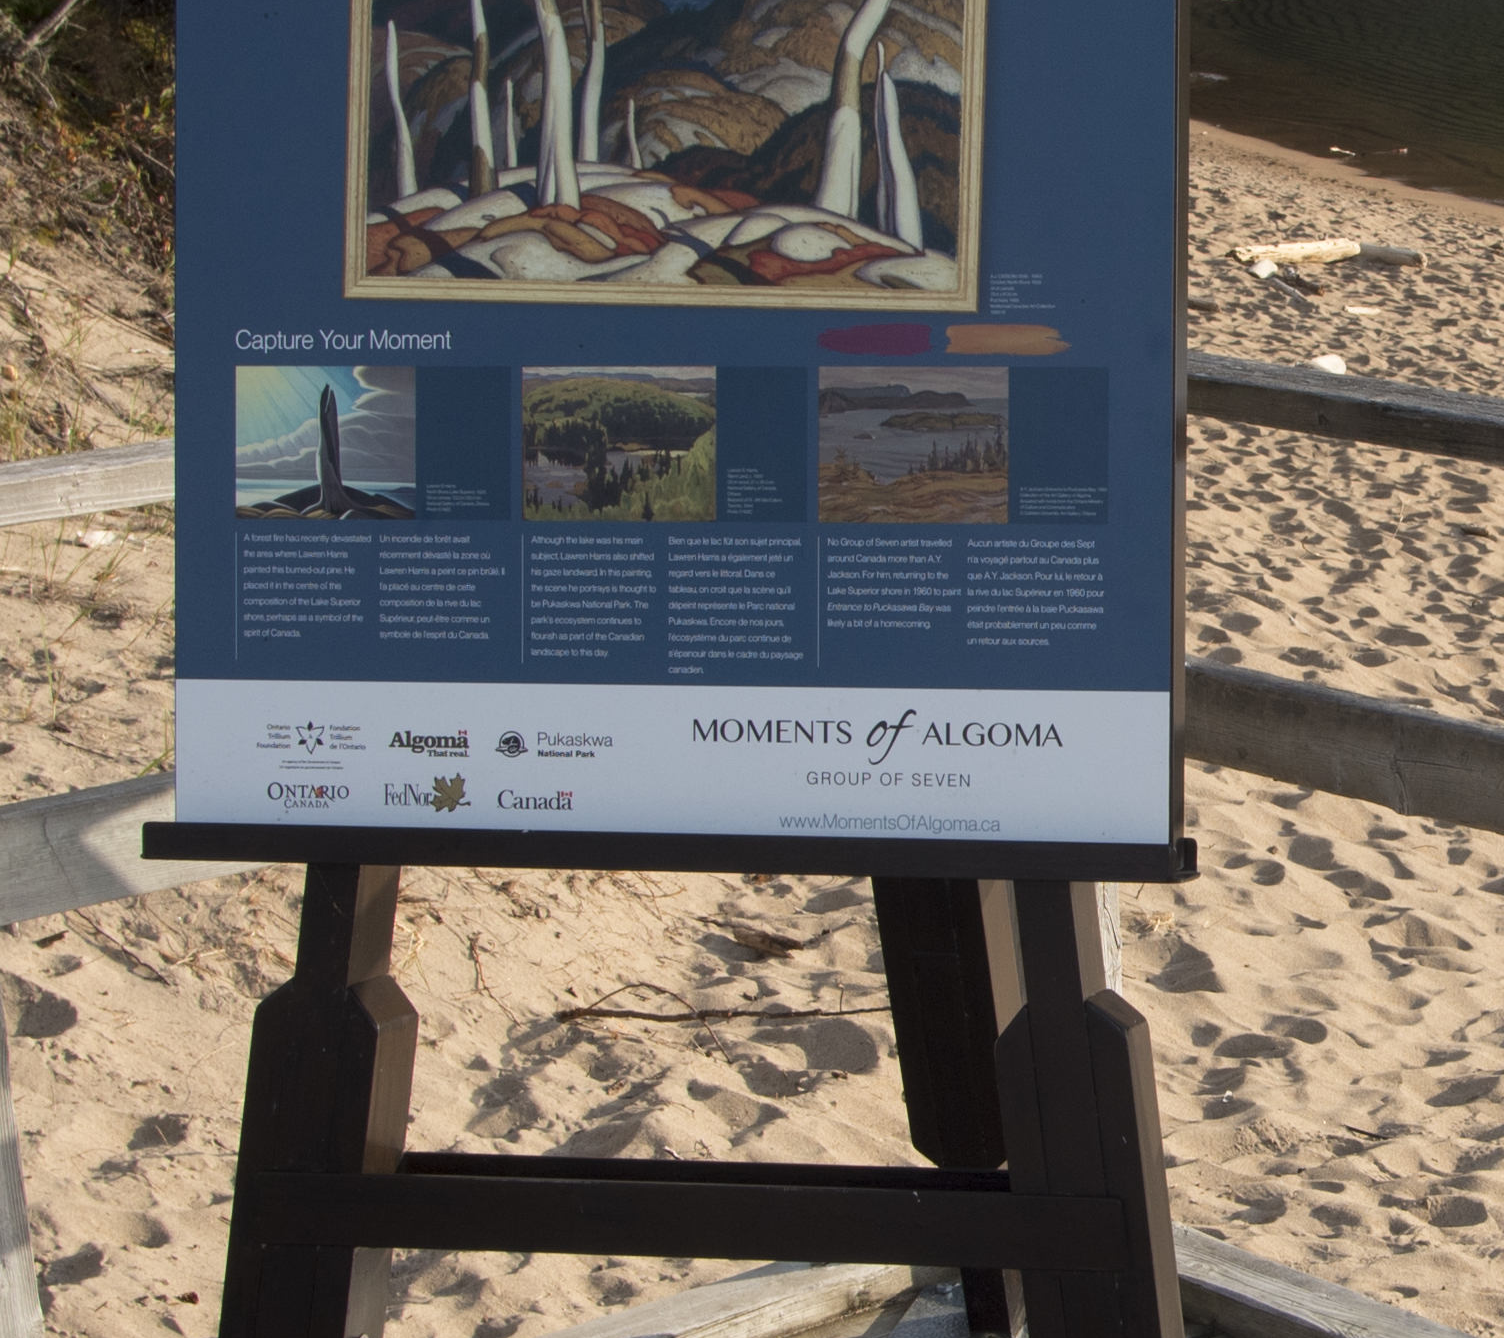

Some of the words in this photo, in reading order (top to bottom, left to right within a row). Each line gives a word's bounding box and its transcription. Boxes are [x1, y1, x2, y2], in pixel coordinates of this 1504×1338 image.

[236, 329, 313, 354] Capture
[319, 329, 364, 349] Your
[370, 330, 451, 349] Moment
[244, 533, 249, 542] A
[251, 533, 271, 542] forest
[272, 533, 284, 542] fire
[285, 533, 299, 542] had
[300, 534, 329, 543] recently
[330, 533, 371, 542] devastated
[379, 534, 390, 542] Un
[391, 534, 422, 542] incendie
[423, 534, 433, 543] de
[434, 534, 451, 543] forêt
[452, 534, 469, 543] avait
[531, 536, 564, 545] Although
[565, 535, 577, 544] the
[579, 535, 594, 544] lake
[612, 535, 623, 544] his
[624, 535, 642, 544] main
[668, 536, 685, 545] Bien
[686, 538, 701, 547] que
[702, 536, 709, 545] le
[710, 536, 722, 545] lac
[723, 536, 733, 545] fût
[749, 537, 767, 546] sujet
[827, 538, 839, 546] No
[840, 538, 864, 548] Group
[865, 538, 873, 546] of
[874, 538, 899, 546] Seven
[900, 538, 919, 546] artist
[920, 538, 952, 546] travelled
[968, 539, 992, 547] Aucun
[993, 539, 1017, 547] artiste
[1018, 539, 1029, 547] du
[1030, 539, 1059, 549] Groupe
[1060, 539, 1075, 547] des
[1076, 539, 1094, 549] Sept
[243, 549, 255, 557] the
[274, 549, 296, 558] where
[298, 549, 325, 558] Lawren
[326, 549, 347, 558] Harris
[379, 550, 421, 559] récemment
[422, 550, 451, 559] dévasté
[452, 550, 459, 559] la
[480, 550, 490, 559] où
[560, 551, 588, 560] Lawren
[589, 551, 611, 560] Harris
[612, 551, 628, 560] also
[629, 552, 654, 560] shifted
[827, 554, 854, 562] around
[855, 554, 886, 562] Canada
[909, 554, 926, 562] than
[980, 555, 1008, 565] voyagé
[1009, 556, 1037, 565] partout
[1050, 555, 1081, 564] Canada
[1082, 556, 1098, 566] plus
[243, 565, 270, 574] painted
[271, 565, 284, 574] this
[285, 565, 325, 574] burned-out
[344, 565, 354, 574] He
[531, 567, 541, 576] his
[542, 569, 561, 578] gaze
[599, 567, 606, 576] In
[607, 567, 620, 576] this
[389, 729, 469, 754] Algoma
[537, 732, 613, 747] Pukaskwa
[693, 719, 852, 744] MOMENTS
[866, 709, 916, 765] of
[922, 722, 1063, 747] ALGOMA
[256, 741, 291, 750] Foundation
[329, 742, 337, 751] de
[339, 742, 366, 751] l'Ontario
[426, 749, 448, 757] That
[538, 749, 573, 758] National
[576, 749, 595, 758] Park
[806, 771, 871, 786] GROUP
[880, 772, 903, 786] OF
[912, 773, 970, 787] SEVEN
[267, 781, 350, 802] ONTARIO
[384, 784, 432, 806] FedNor
[284, 799, 330, 809] CANADA
[498, 790, 572, 810] Canada
[779, 813, 1001, 835] www.MomentsOfAlgoma.ca
